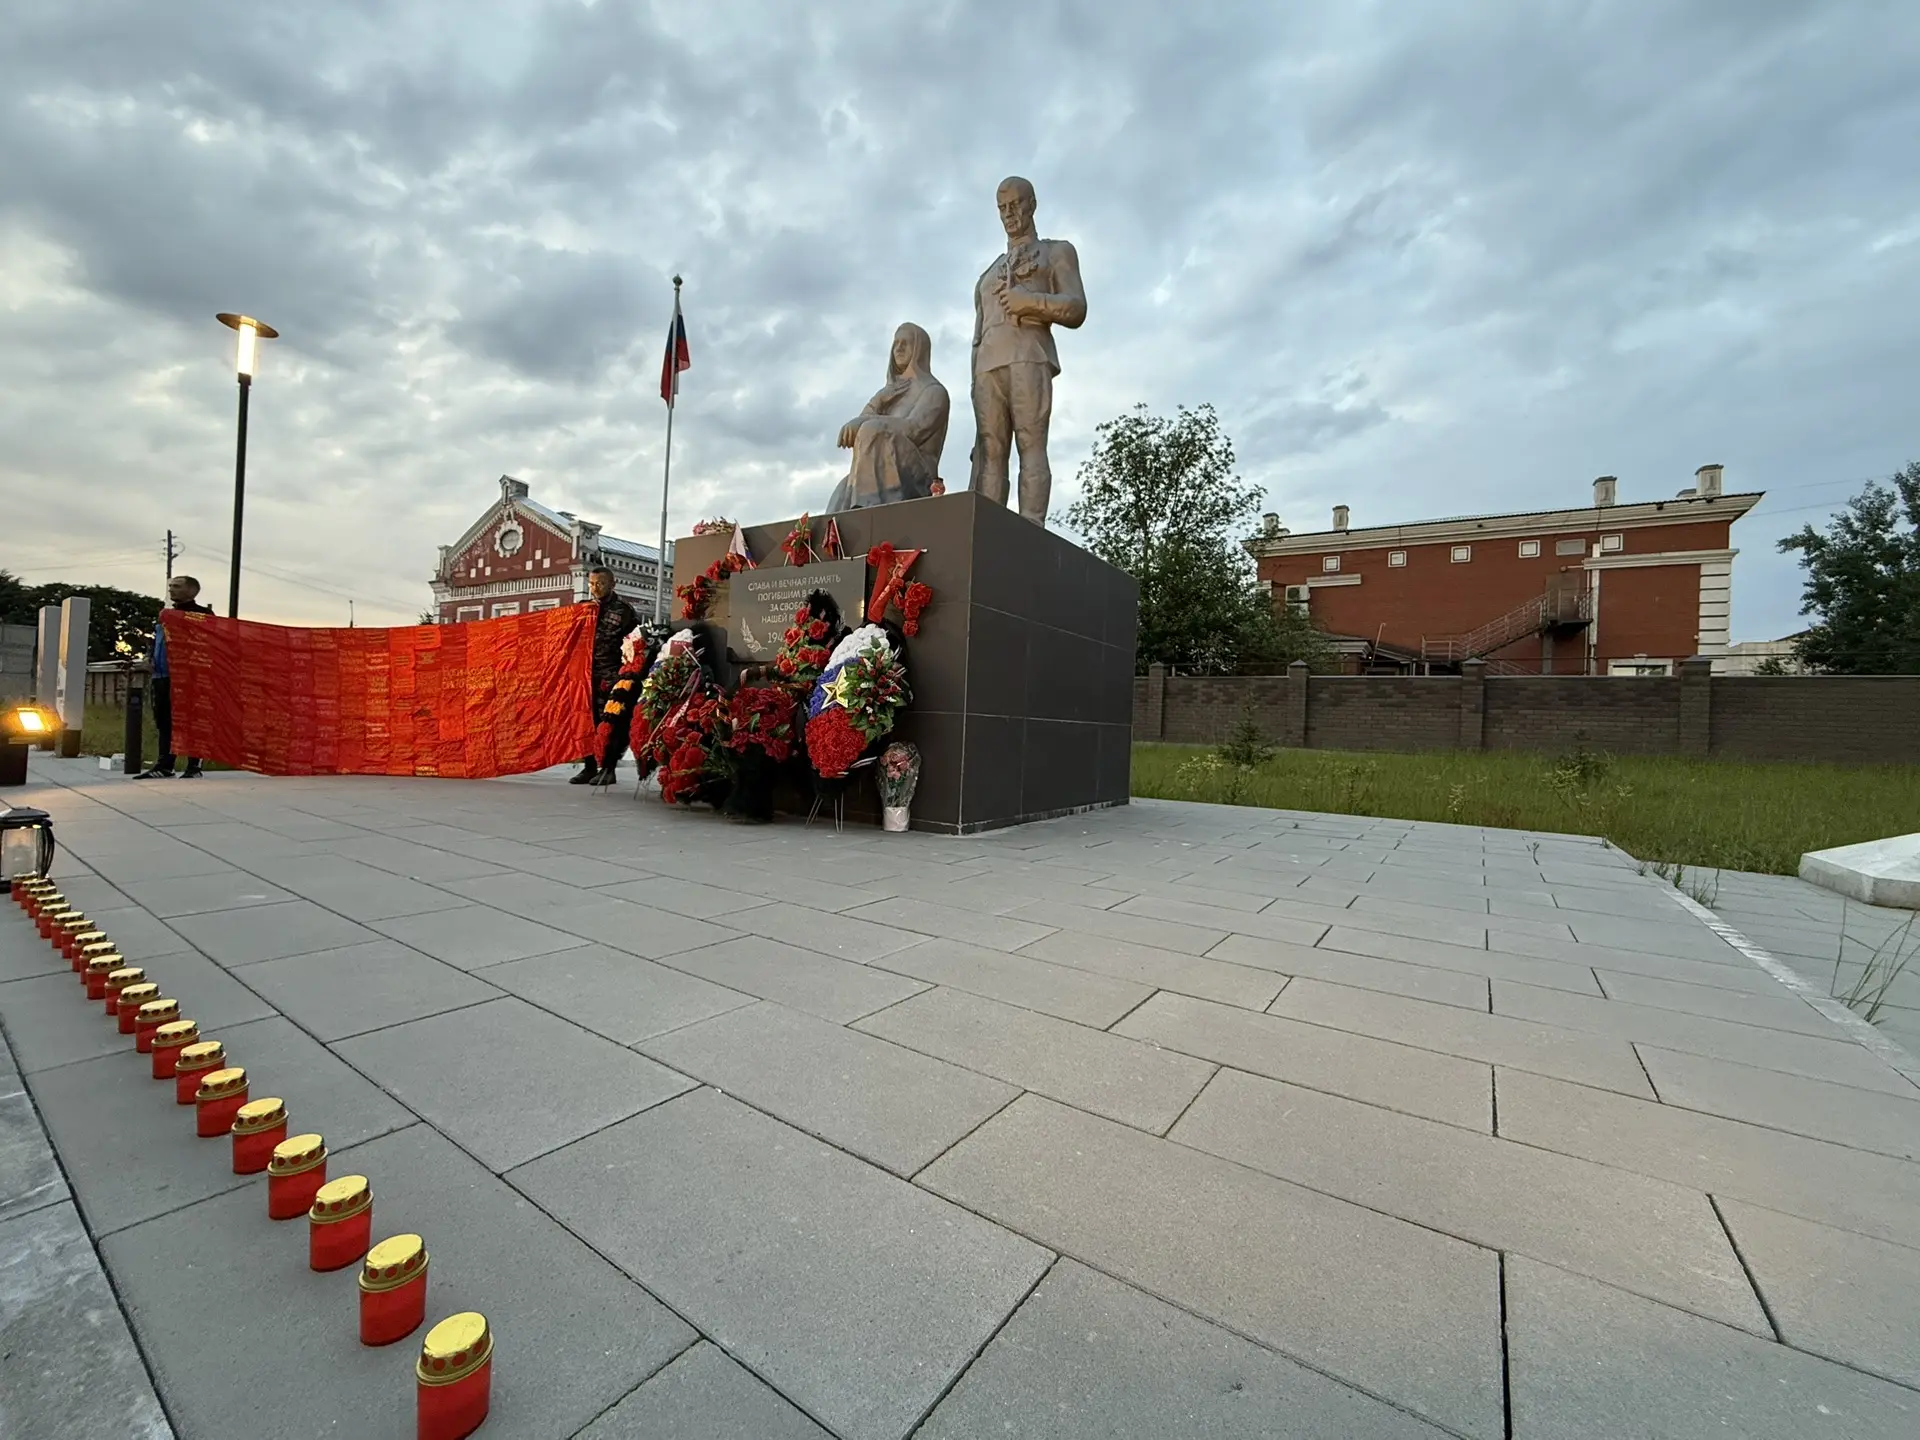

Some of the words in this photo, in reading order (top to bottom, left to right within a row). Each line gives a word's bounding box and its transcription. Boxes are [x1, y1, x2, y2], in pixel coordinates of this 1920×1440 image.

[747, 581, 770, 591] СЛАВА
[771, 580, 777, 588] И
[778, 577, 807, 588] ВЕЧНАЯ
[808, 574, 841, 584] ПАМЯТЬ
[757, 590, 800, 601] ПОГИБШИМ
[801, 589, 807, 598] В
[769, 603, 778, 612] ЗА
[761, 612, 788, 623] НАШЕЙ
